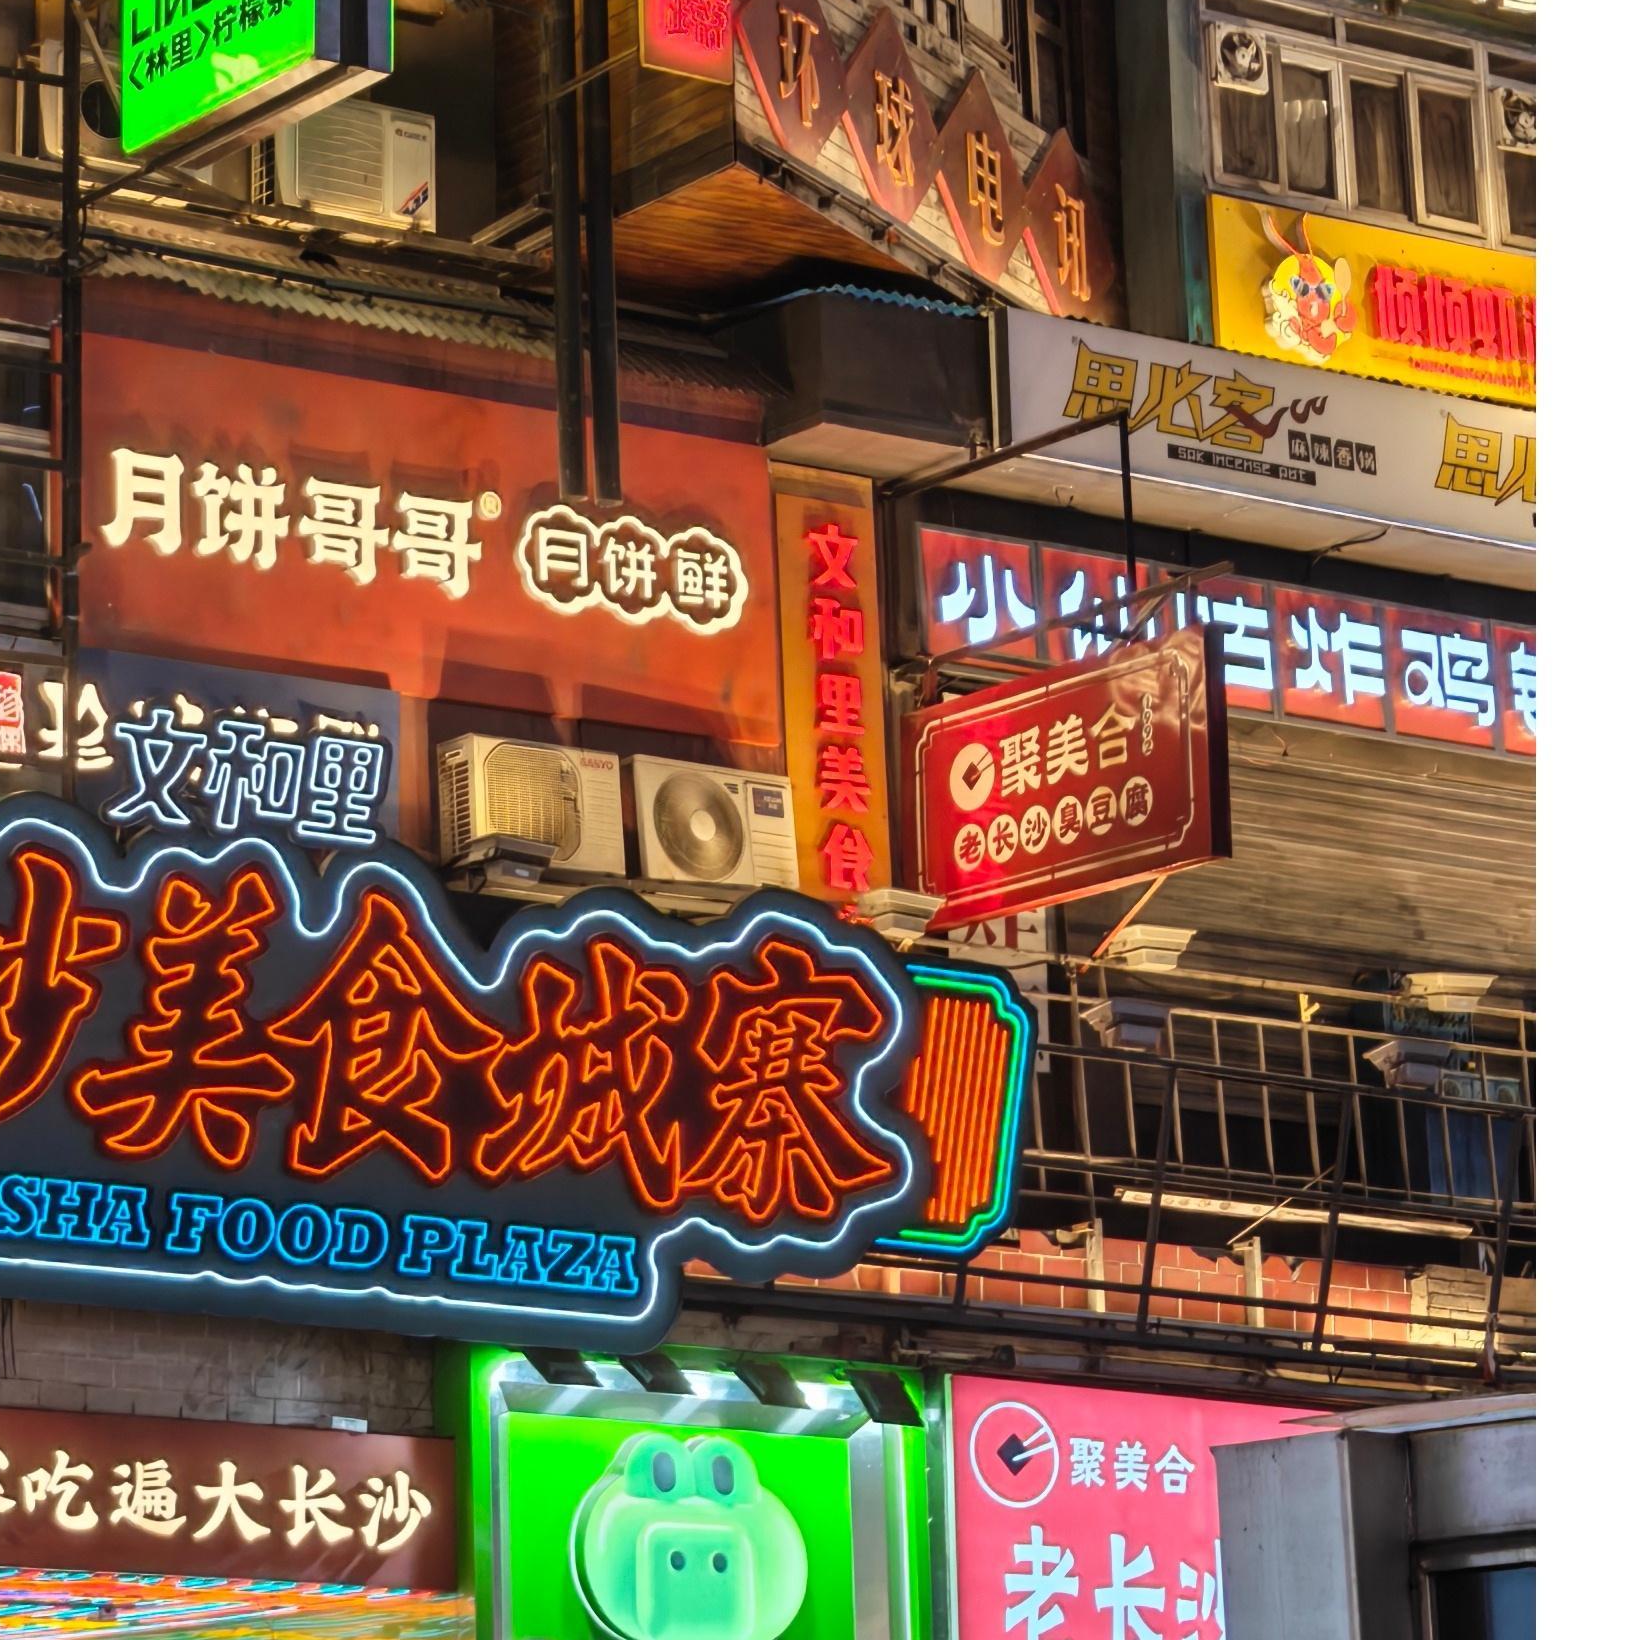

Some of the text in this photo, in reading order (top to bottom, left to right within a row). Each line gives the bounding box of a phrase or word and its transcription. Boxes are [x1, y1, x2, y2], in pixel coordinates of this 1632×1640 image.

[1063, 337, 1276, 454] 思必客
[534, 527, 731, 610] 月饼鲜
[806, 522, 876, 924] 文和里美食
[999, 702, 1136, 797] 聚美合
[1141, 693, 1154, 757] 1992
[108, 709, 385, 847] 文和里
[956, 779, 1151, 867] 老长沙臭豆腐
[165, 1191, 390, 1268] FOOD
[397, 1214, 640, 1297] PLAZA
[1068, 1434, 1197, 1497] 聚美合
